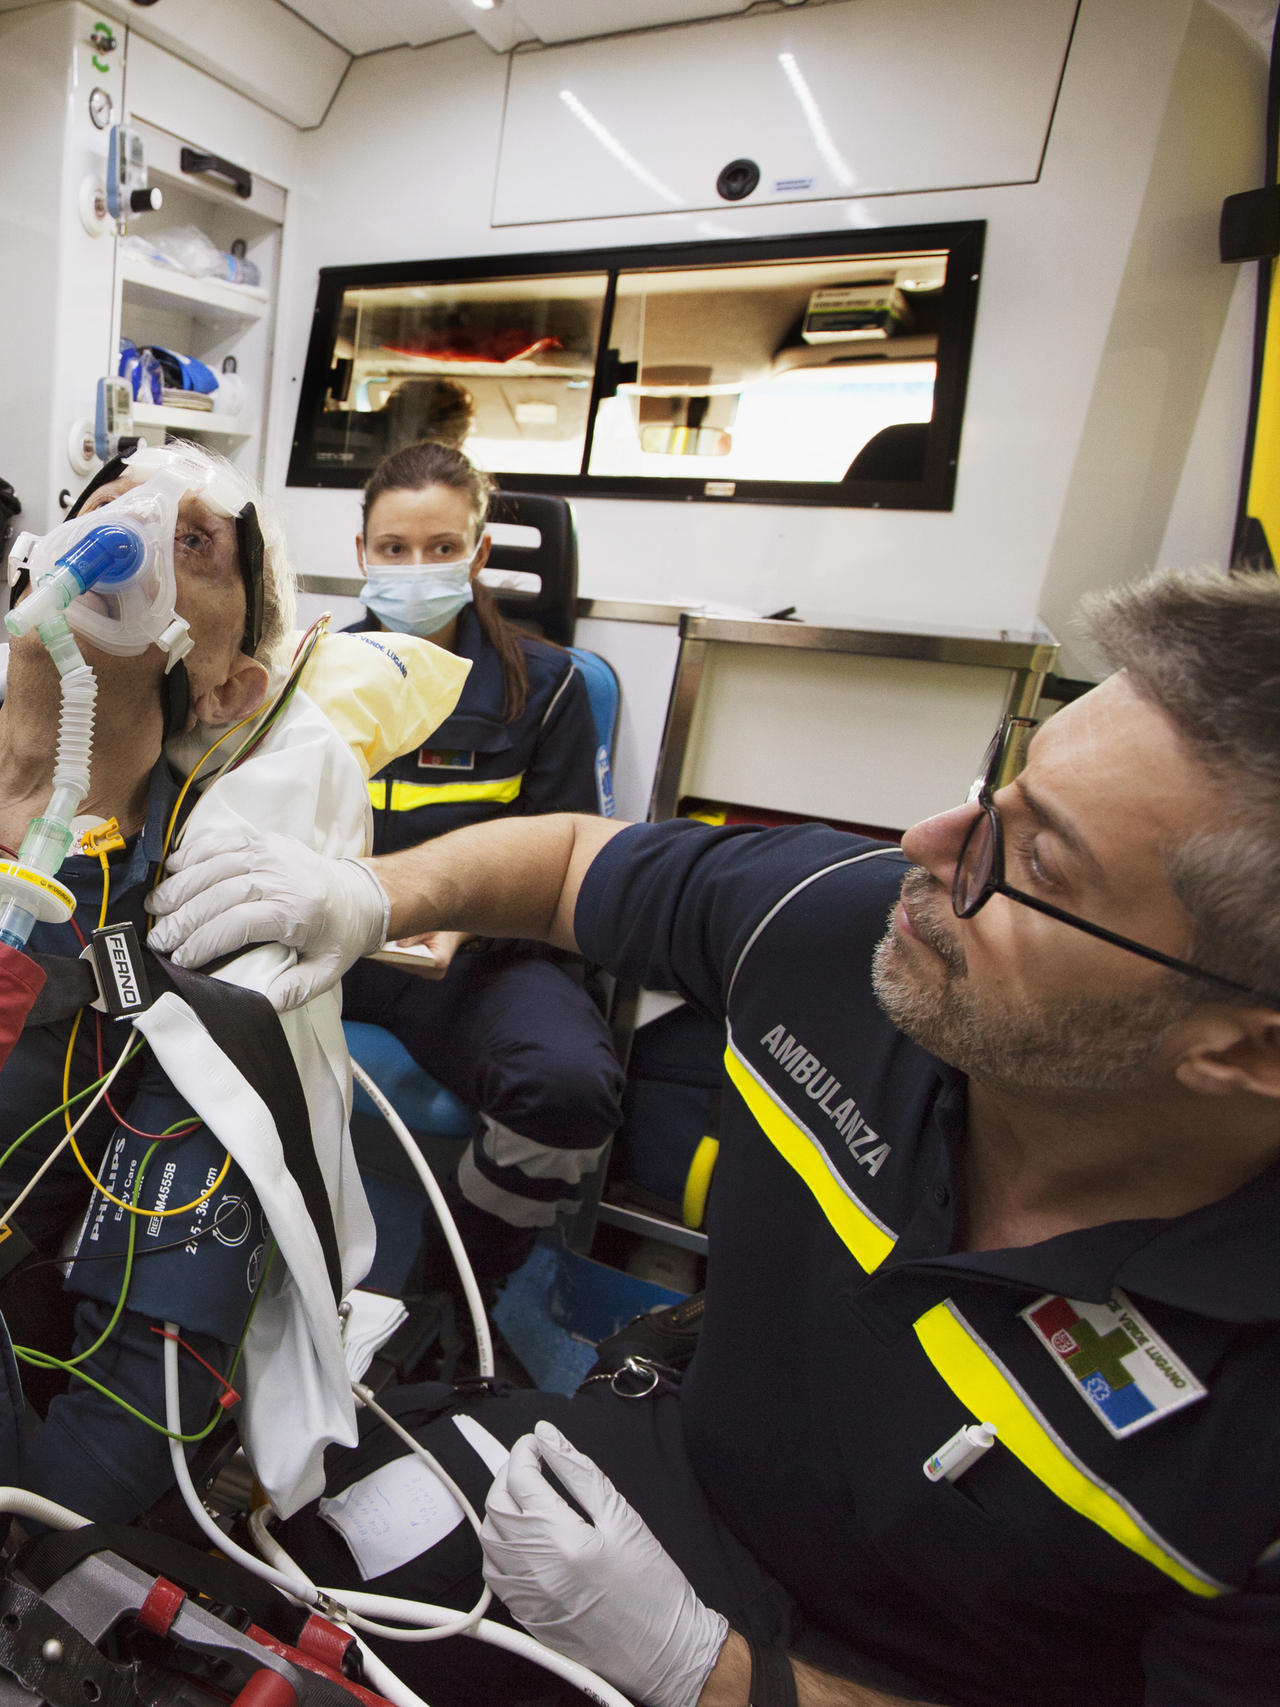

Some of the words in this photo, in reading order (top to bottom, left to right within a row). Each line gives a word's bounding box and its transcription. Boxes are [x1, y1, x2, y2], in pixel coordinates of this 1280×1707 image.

[110, 937, 136, 1003] FERNO
[760, 1024, 892, 1177] AMBULANZA
[124, 1160, 137, 1187] Care
[154, 1162, 176, 1212] M4555B
[206, 1167, 218, 1188] cm
[149, 1216, 161, 1234] REF
[1119, 1312, 1150, 1346] VERDE
[1145, 1346, 1187, 1389] LUGANO
